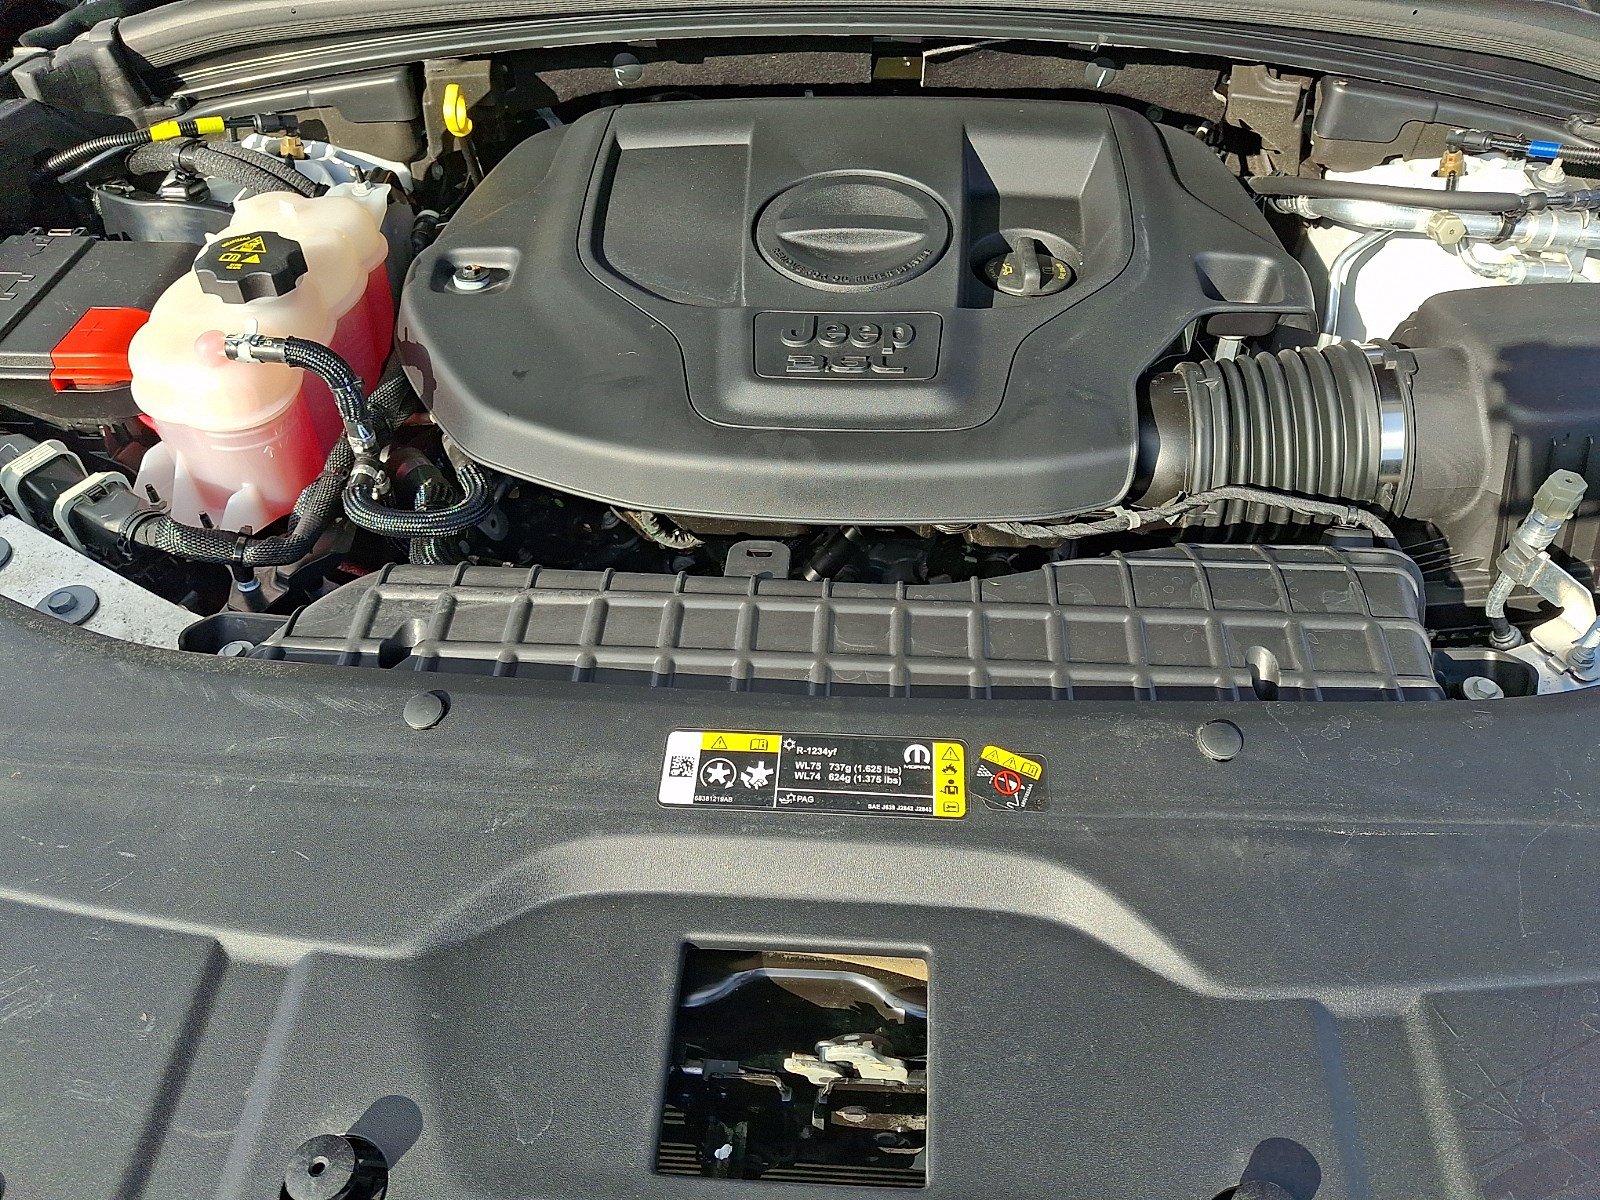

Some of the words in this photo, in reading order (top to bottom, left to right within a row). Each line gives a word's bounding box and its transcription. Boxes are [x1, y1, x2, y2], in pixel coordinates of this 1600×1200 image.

[780, 315, 917, 355] Jeep
[796, 746, 838, 756] R-1234yf
[795, 761, 822, 771] WL75
[829, 763, 852, 773] 737g
[853, 765, 882, 774] (1.625
[884, 765, 902, 775] lbs)
[794, 771, 821, 780] WL74
[828, 773, 852, 783] 624g
[853, 774, 882, 784] (1.375
[883, 775, 902, 785] lbs)
